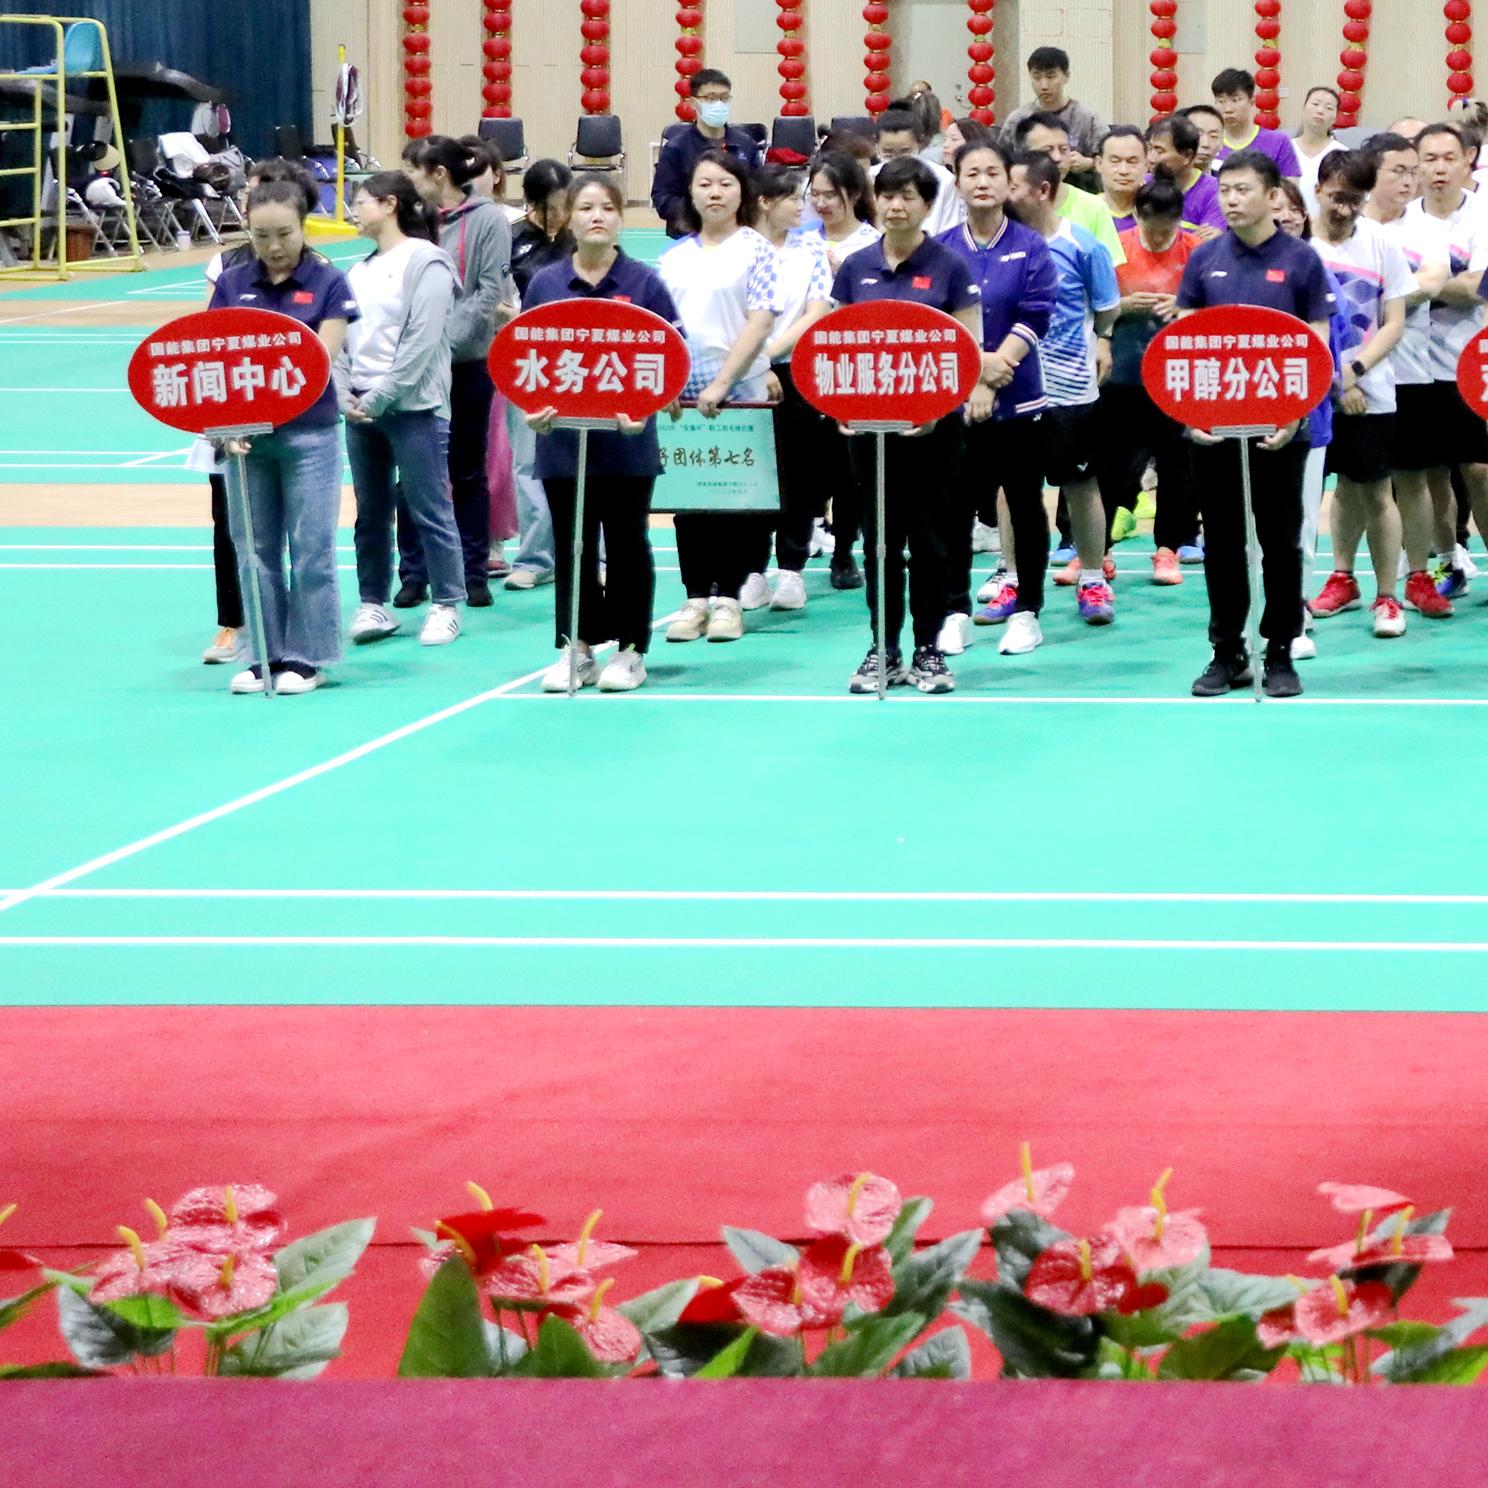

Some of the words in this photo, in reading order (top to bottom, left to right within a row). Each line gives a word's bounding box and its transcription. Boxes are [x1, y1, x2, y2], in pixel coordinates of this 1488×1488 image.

[153, 355, 307, 407] 新闻中心
[514, 348, 667, 395] 水务公司
[814, 351, 959, 397] 物业服务分公司
[1164, 356, 1309, 402] 甲醇分公司
